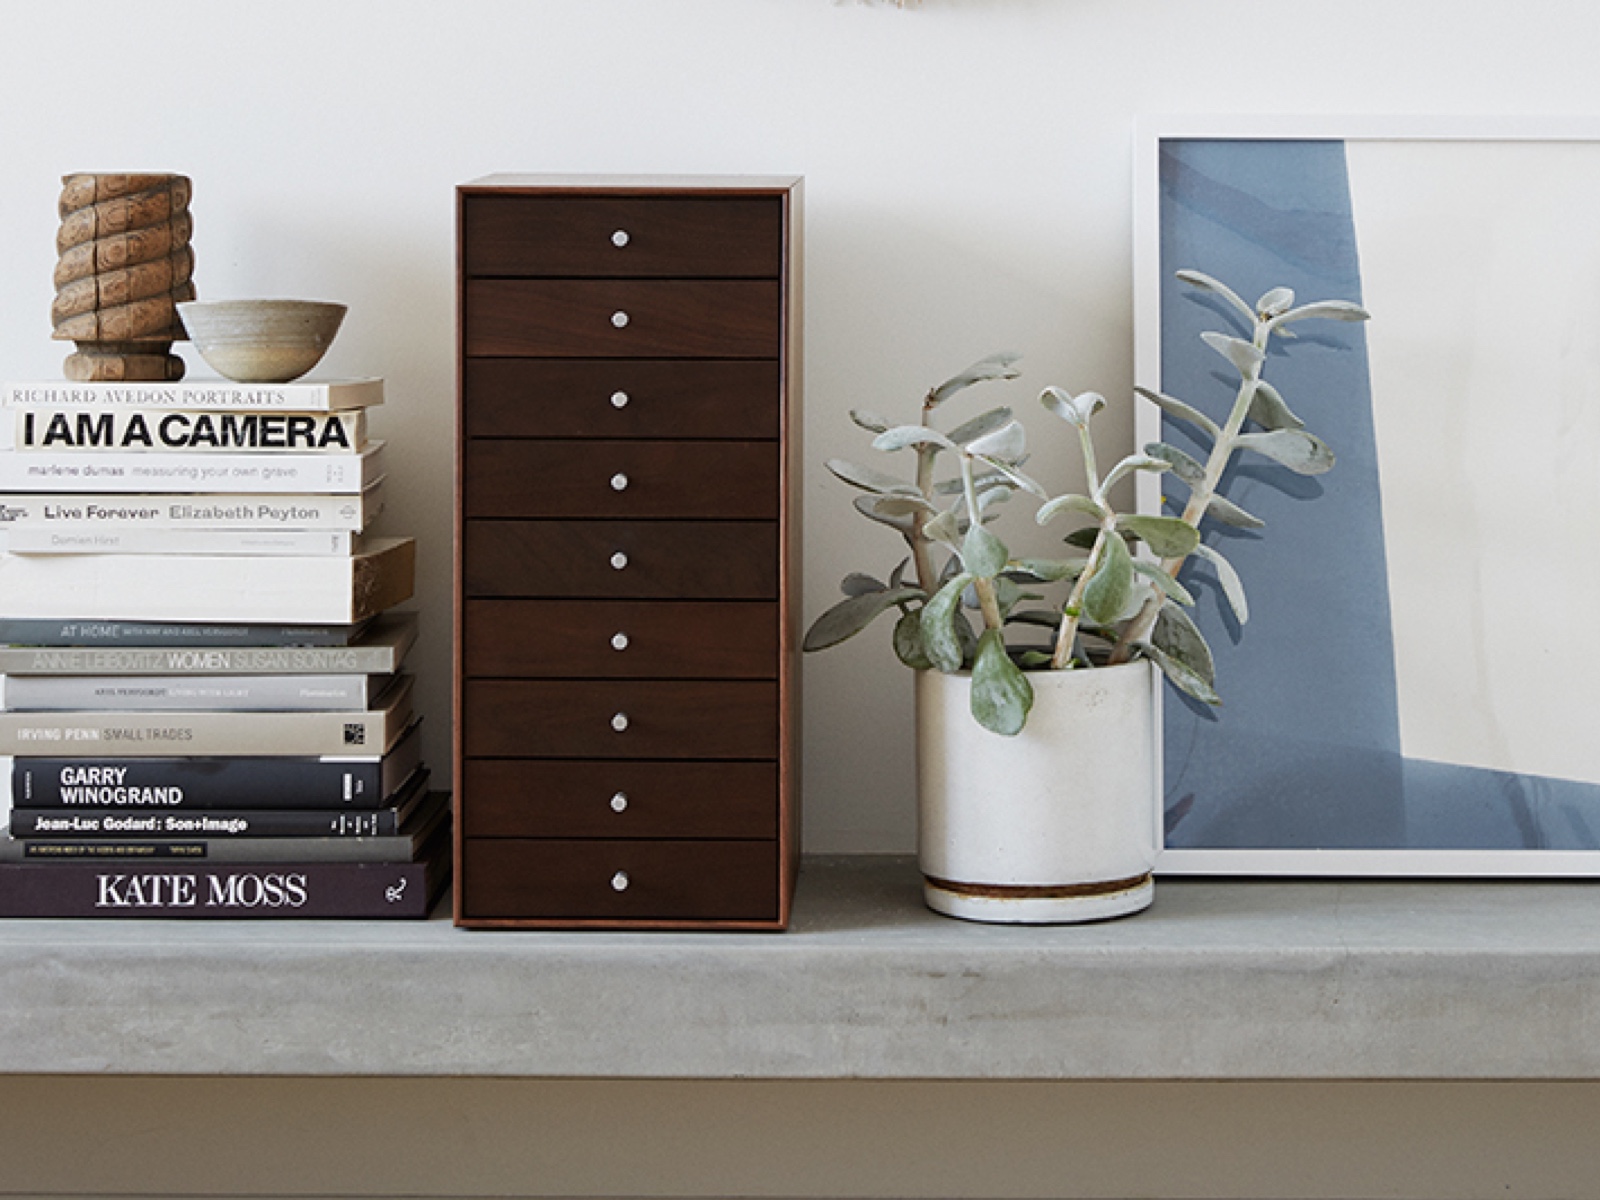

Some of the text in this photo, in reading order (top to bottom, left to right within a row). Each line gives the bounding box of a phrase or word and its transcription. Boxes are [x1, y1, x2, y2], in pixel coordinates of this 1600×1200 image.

[13, 389, 286, 405] RICHARD AVEDON PORTRAITS
[25, 412, 349, 448] I AM A CAMERA
[28, 465, 298, 479] marlene dumas measuring your own grave
[44, 505, 82, 519] Live
[87, 505, 159, 519] Forever
[169, 505, 253, 520] Elizabeth
[257, 505, 319, 521] Peyton
[60, 625, 76, 637] AT
[80, 625, 121, 638] HOME
[166, 652, 230, 669] WOMEN
[234, 652, 288, 669] SUSAN
[292, 652, 357, 669] SONTAG
[18, 728, 193, 741] IRVING PENN SMALL TRADES
[60, 767, 127, 786] GARRY
[60, 787, 183, 804] WINOGRAND
[35, 816, 100, 831] Jean-Luc
[166, 816, 248, 833] Son+Image
[95, 873, 308, 908] KATE MOSS
